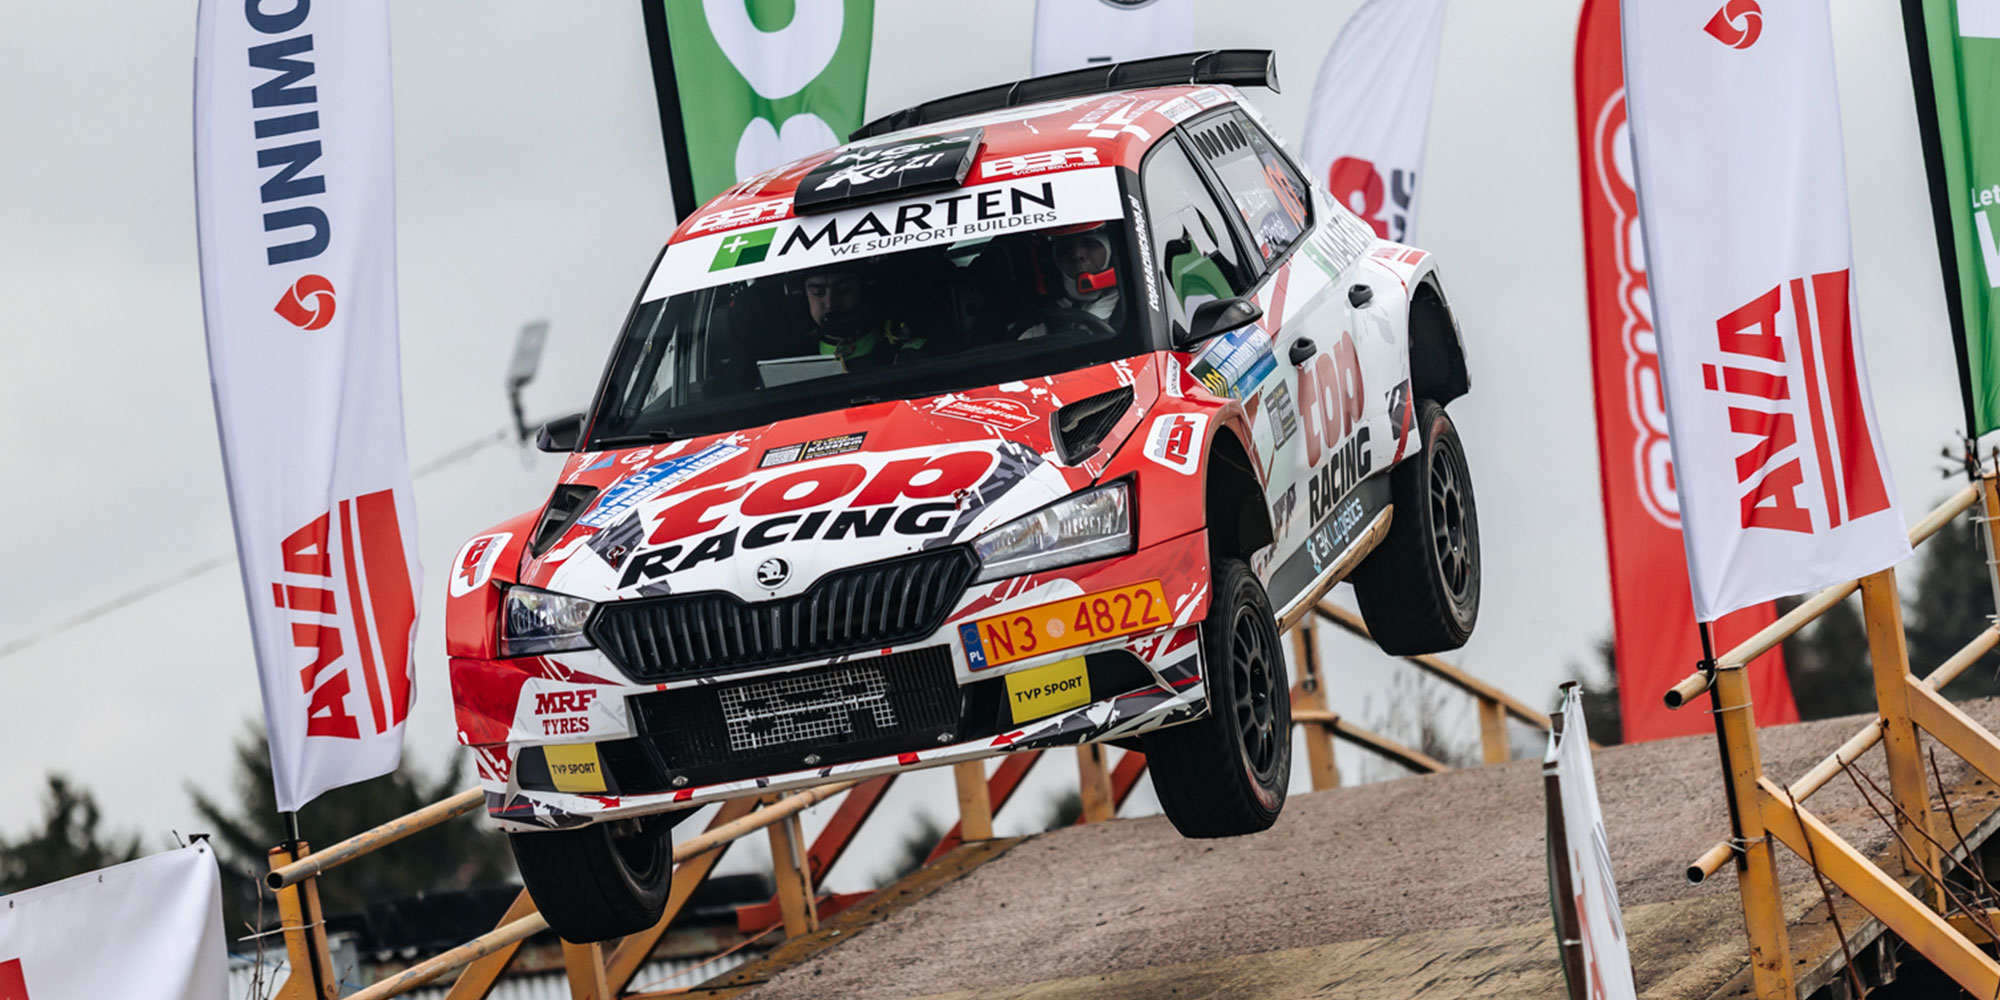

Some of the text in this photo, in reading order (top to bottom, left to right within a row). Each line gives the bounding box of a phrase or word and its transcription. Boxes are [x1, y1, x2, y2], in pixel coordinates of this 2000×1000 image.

[778, 182, 1056, 257] MARTEN
[831, 210, 1057, 257] WE SUPPORT BUILDERS
[1296, 331, 1365, 467] top
[616, 466, 664, 491] 101
[648, 451, 992, 546] top
[1309, 427, 1373, 528] RACING
[1327, 498, 1364, 545] Logistics
[617, 501, 956, 590] RACING
[987, 588, 1160, 660] N3 4822
[969, 651, 985, 663] PL
[535, 689, 597, 716] MRF
[1015, 675, 1083, 703] TVP SPORT
[542, 717, 589, 736] TYRES
[551, 761, 596, 776] TVP SPORT
